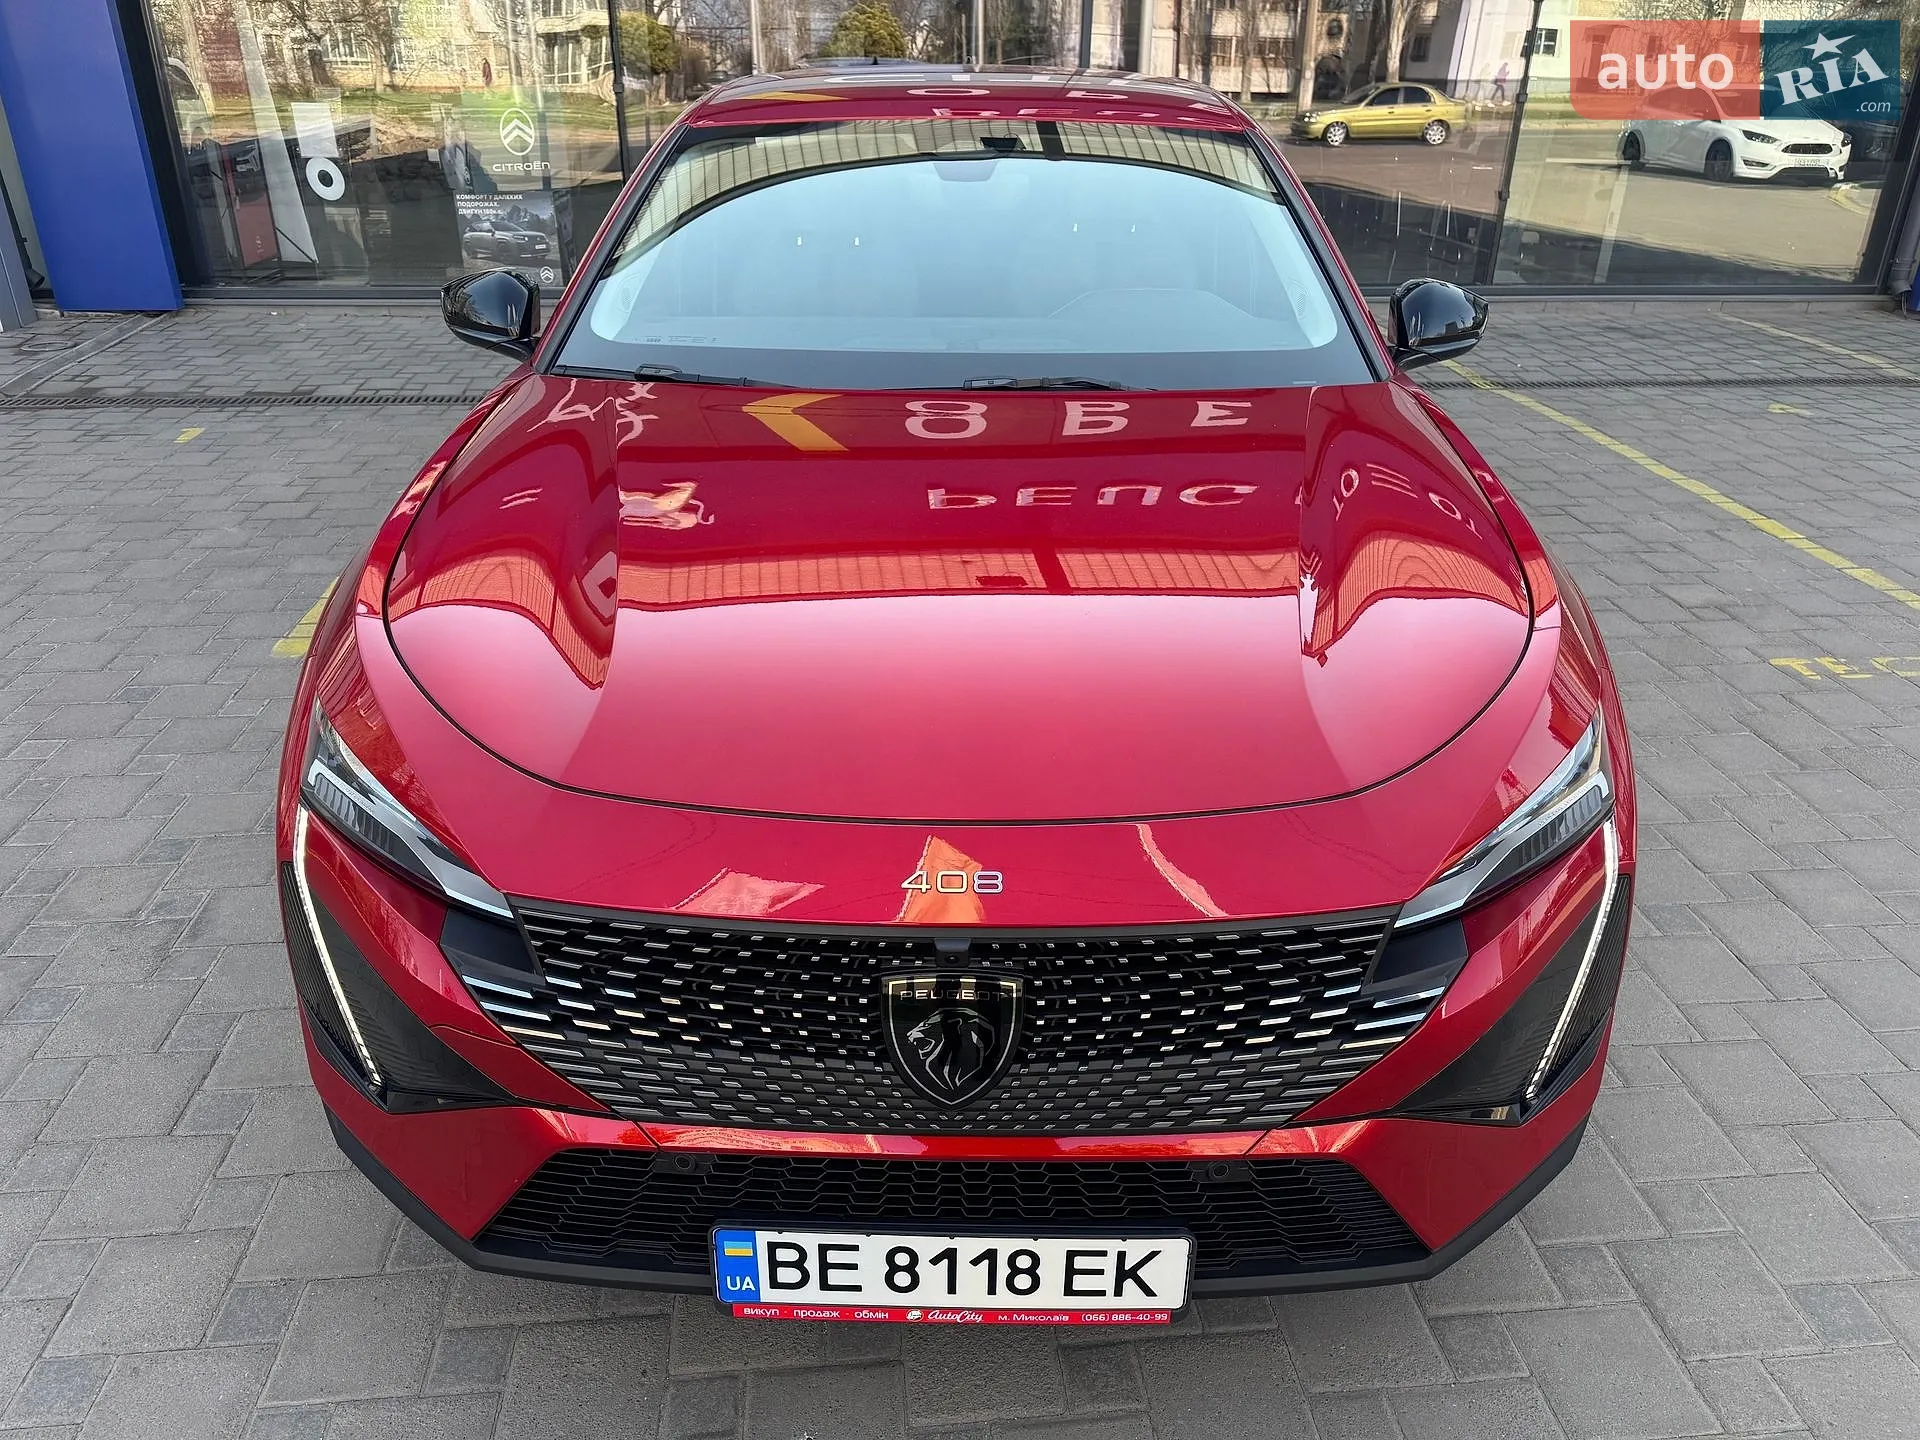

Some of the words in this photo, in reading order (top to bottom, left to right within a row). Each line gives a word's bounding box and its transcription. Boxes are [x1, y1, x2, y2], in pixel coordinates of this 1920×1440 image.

[901, 870, 1003, 894] 408
[900, 989, 1003, 1002] PEUGEOT
[766, 1240, 863, 1292] BE
[884, 1245, 1041, 1297] 8118
[1063, 1249, 1163, 1298] EK
[726, 1275, 756, 1291] UA
[743, 1307, 780, 1317] викуп
[793, 1309, 841, 1319] продаж
[854, 1310, 889, 1319] обмін
[927, 1310, 983, 1323] AutoCity
[1012, 1313, 1070, 1322] Миколаїв
[1081, 1312, 1110, 1323] (066)
[1111, 1313, 1168, 1322] 886-40-99
